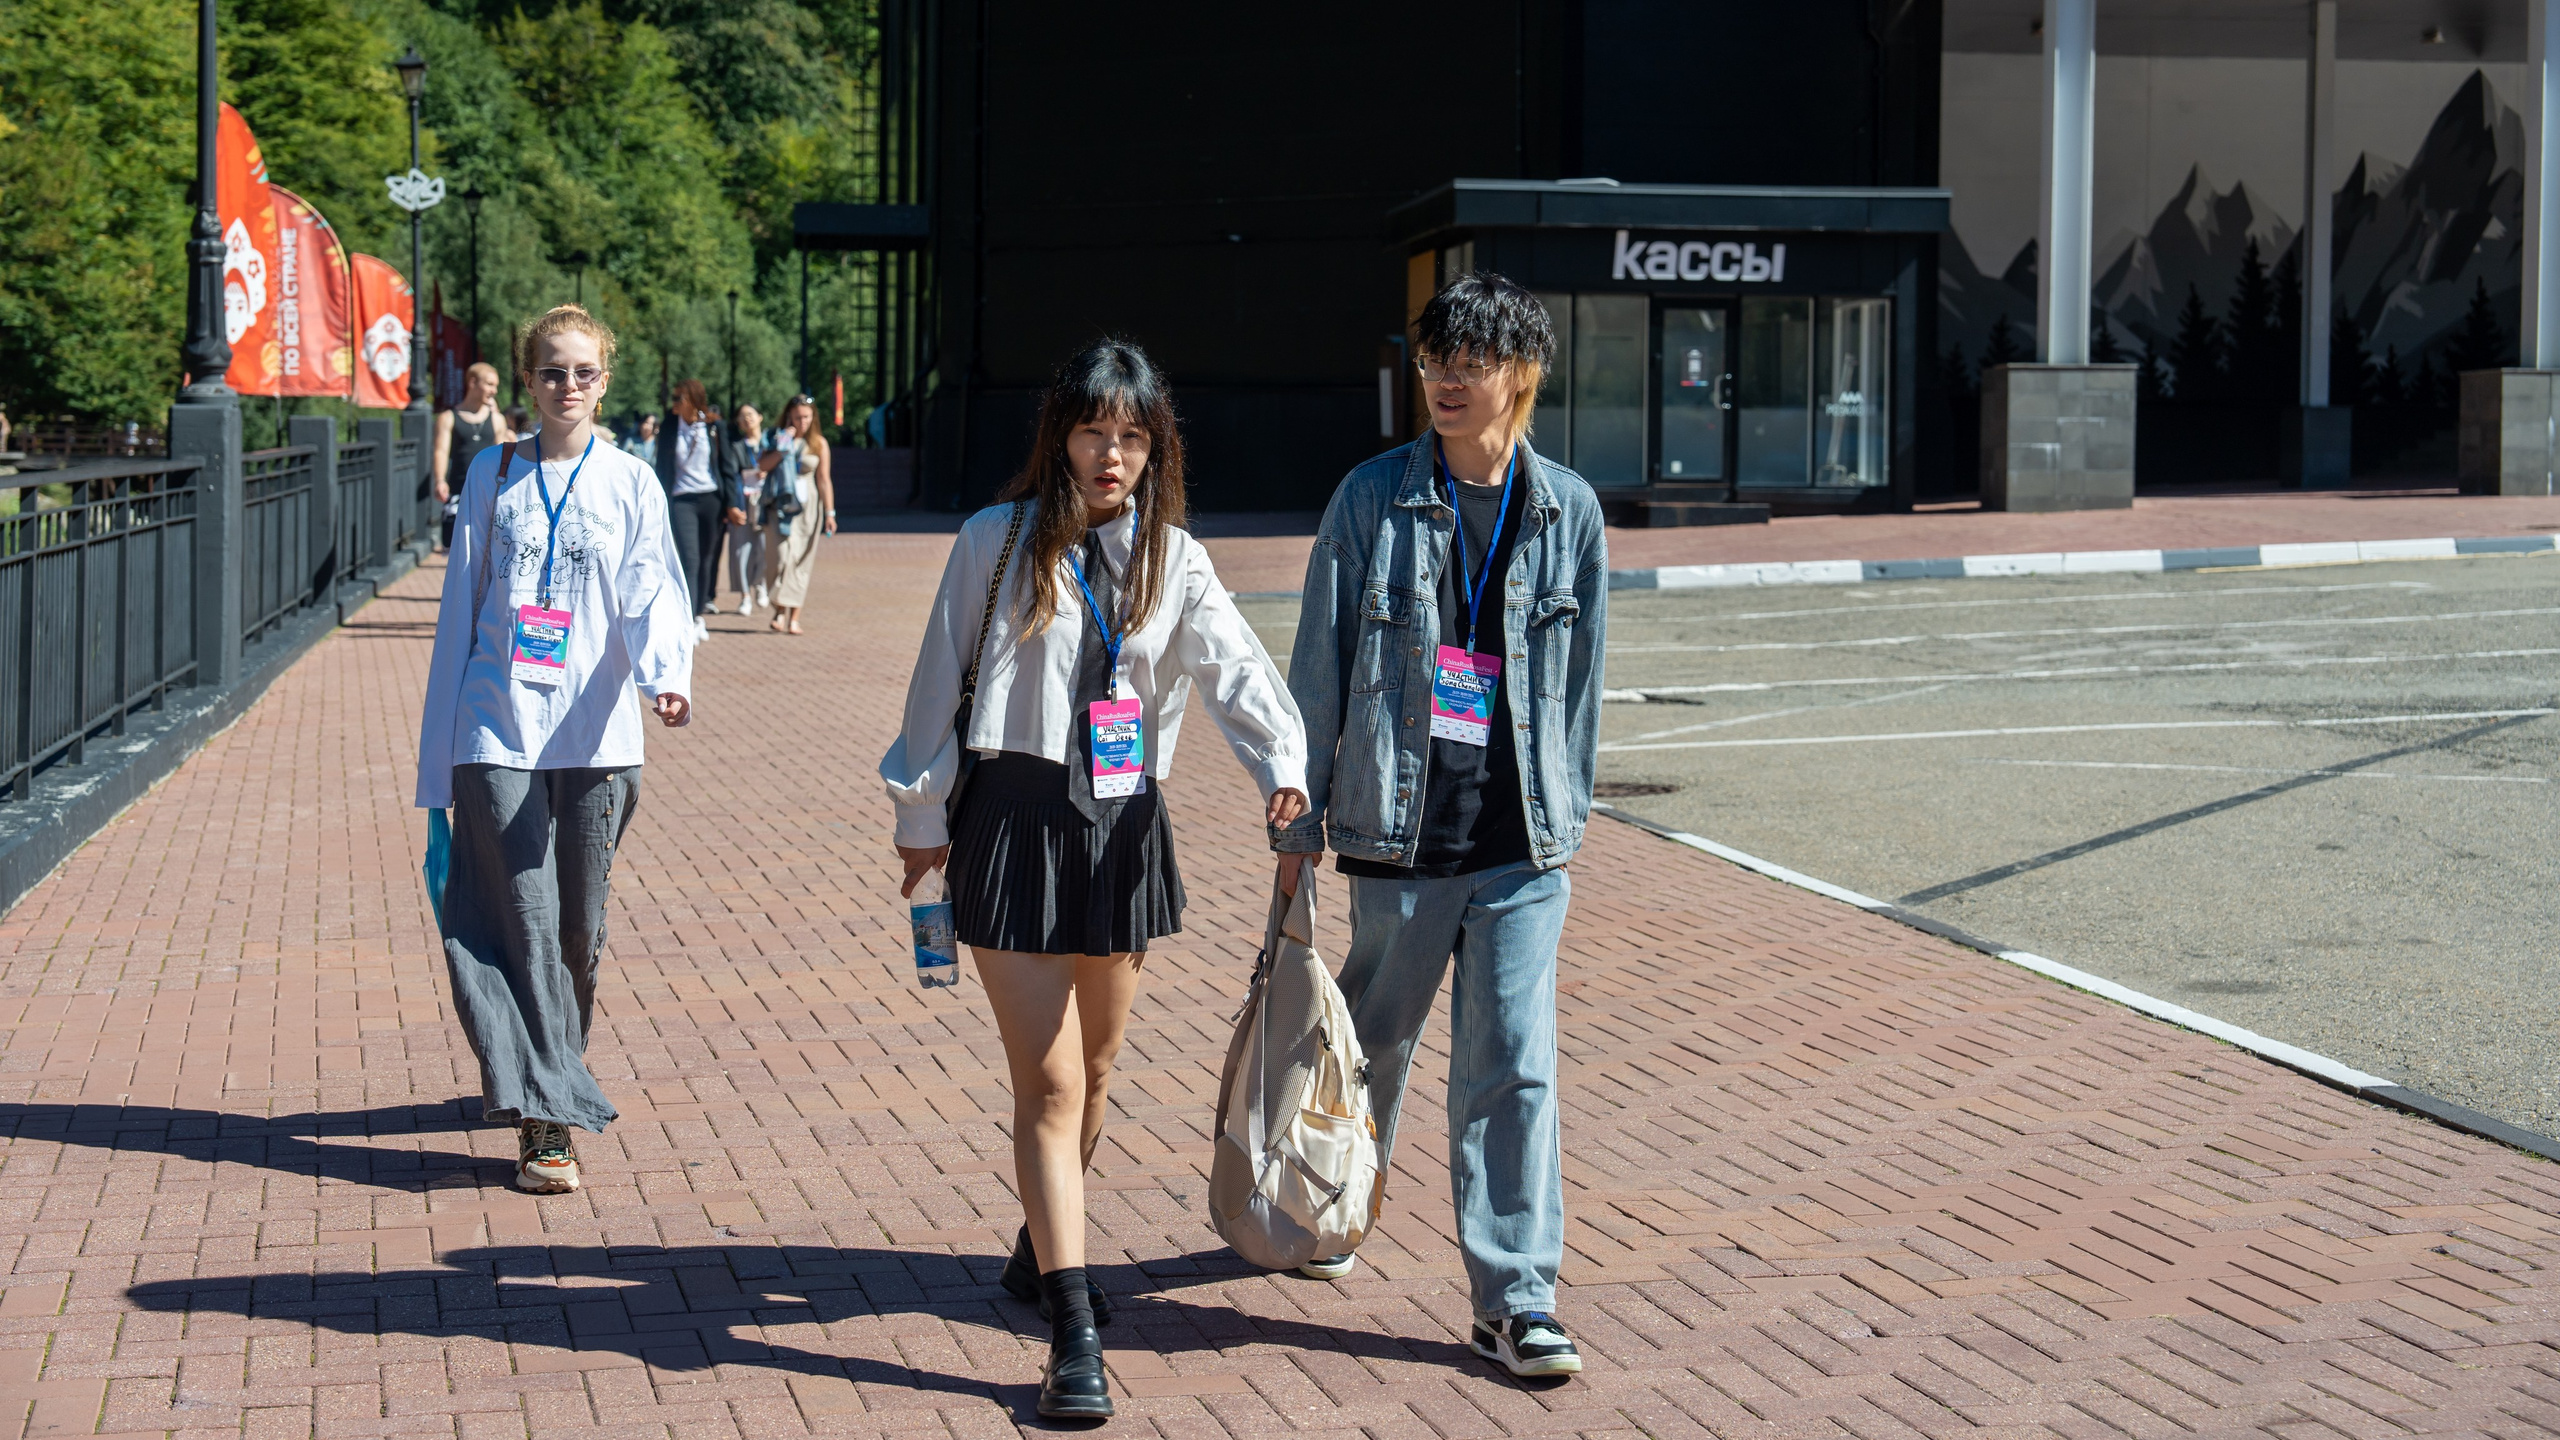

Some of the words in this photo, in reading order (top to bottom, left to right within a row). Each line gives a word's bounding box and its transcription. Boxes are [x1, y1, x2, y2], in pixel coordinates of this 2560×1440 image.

[281, 227, 298, 297] СТРАНЕ
[281, 298, 300, 346] ВСЕЙ
[283, 347, 300, 376] ПО
[494, 510, 519, 531] You
[578, 507, 615, 535] crush
[1447, 670, 1485, 685] УЧАСТНИК
[1529, 1311, 1547, 1320] NIKE
